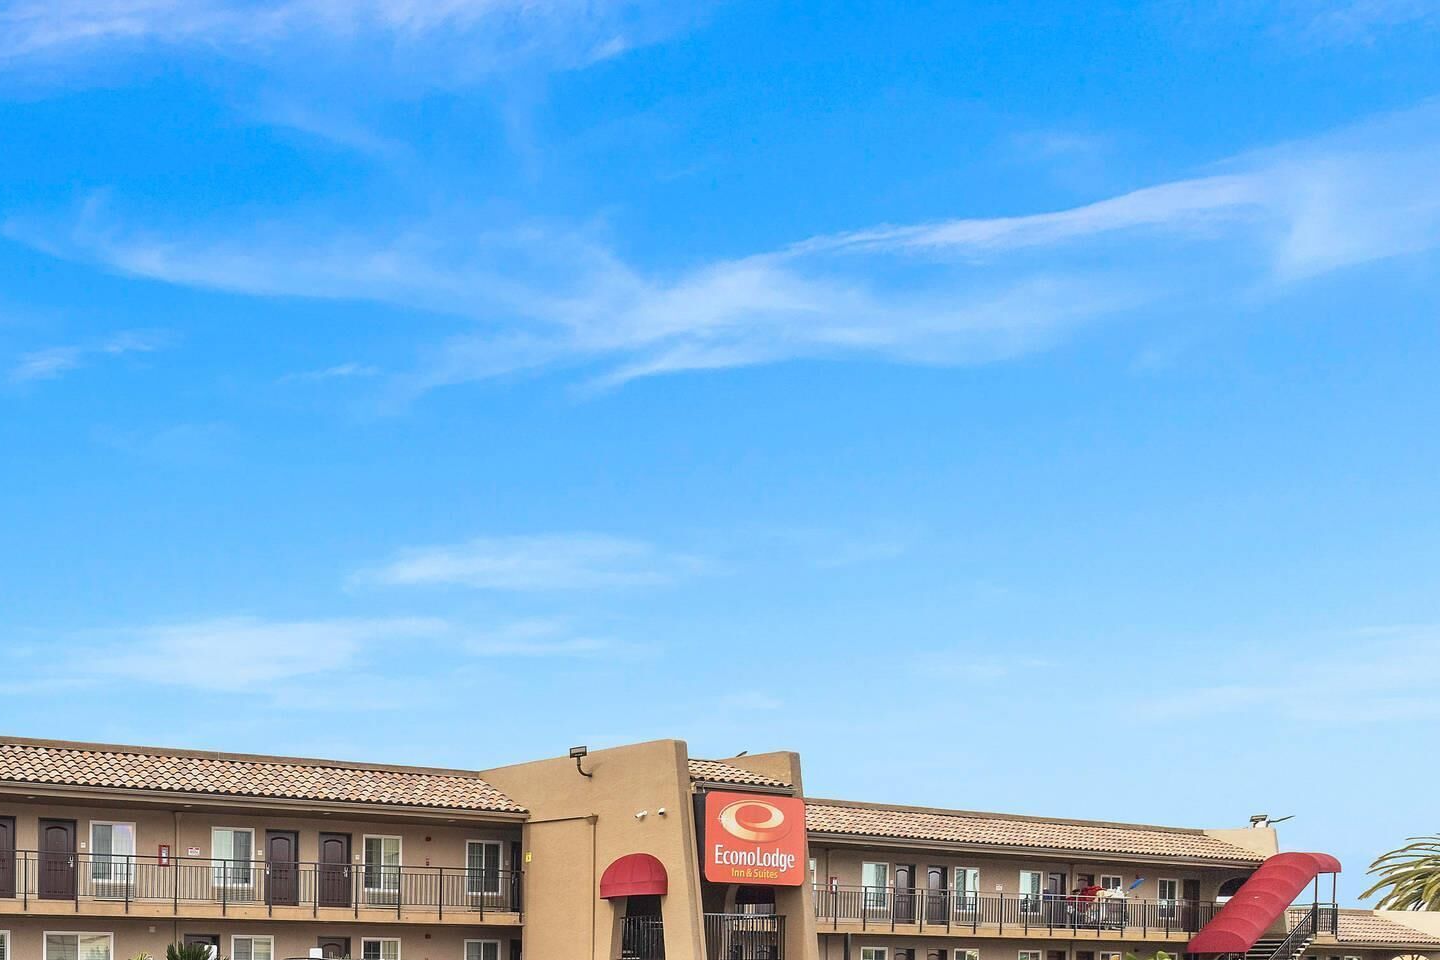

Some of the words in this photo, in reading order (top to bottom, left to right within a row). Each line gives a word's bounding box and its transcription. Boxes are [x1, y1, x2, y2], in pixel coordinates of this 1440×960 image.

[731, 867, 745, 878] Inn
[746, 868, 753, 878] &
[753, 868, 778, 879] Suites
